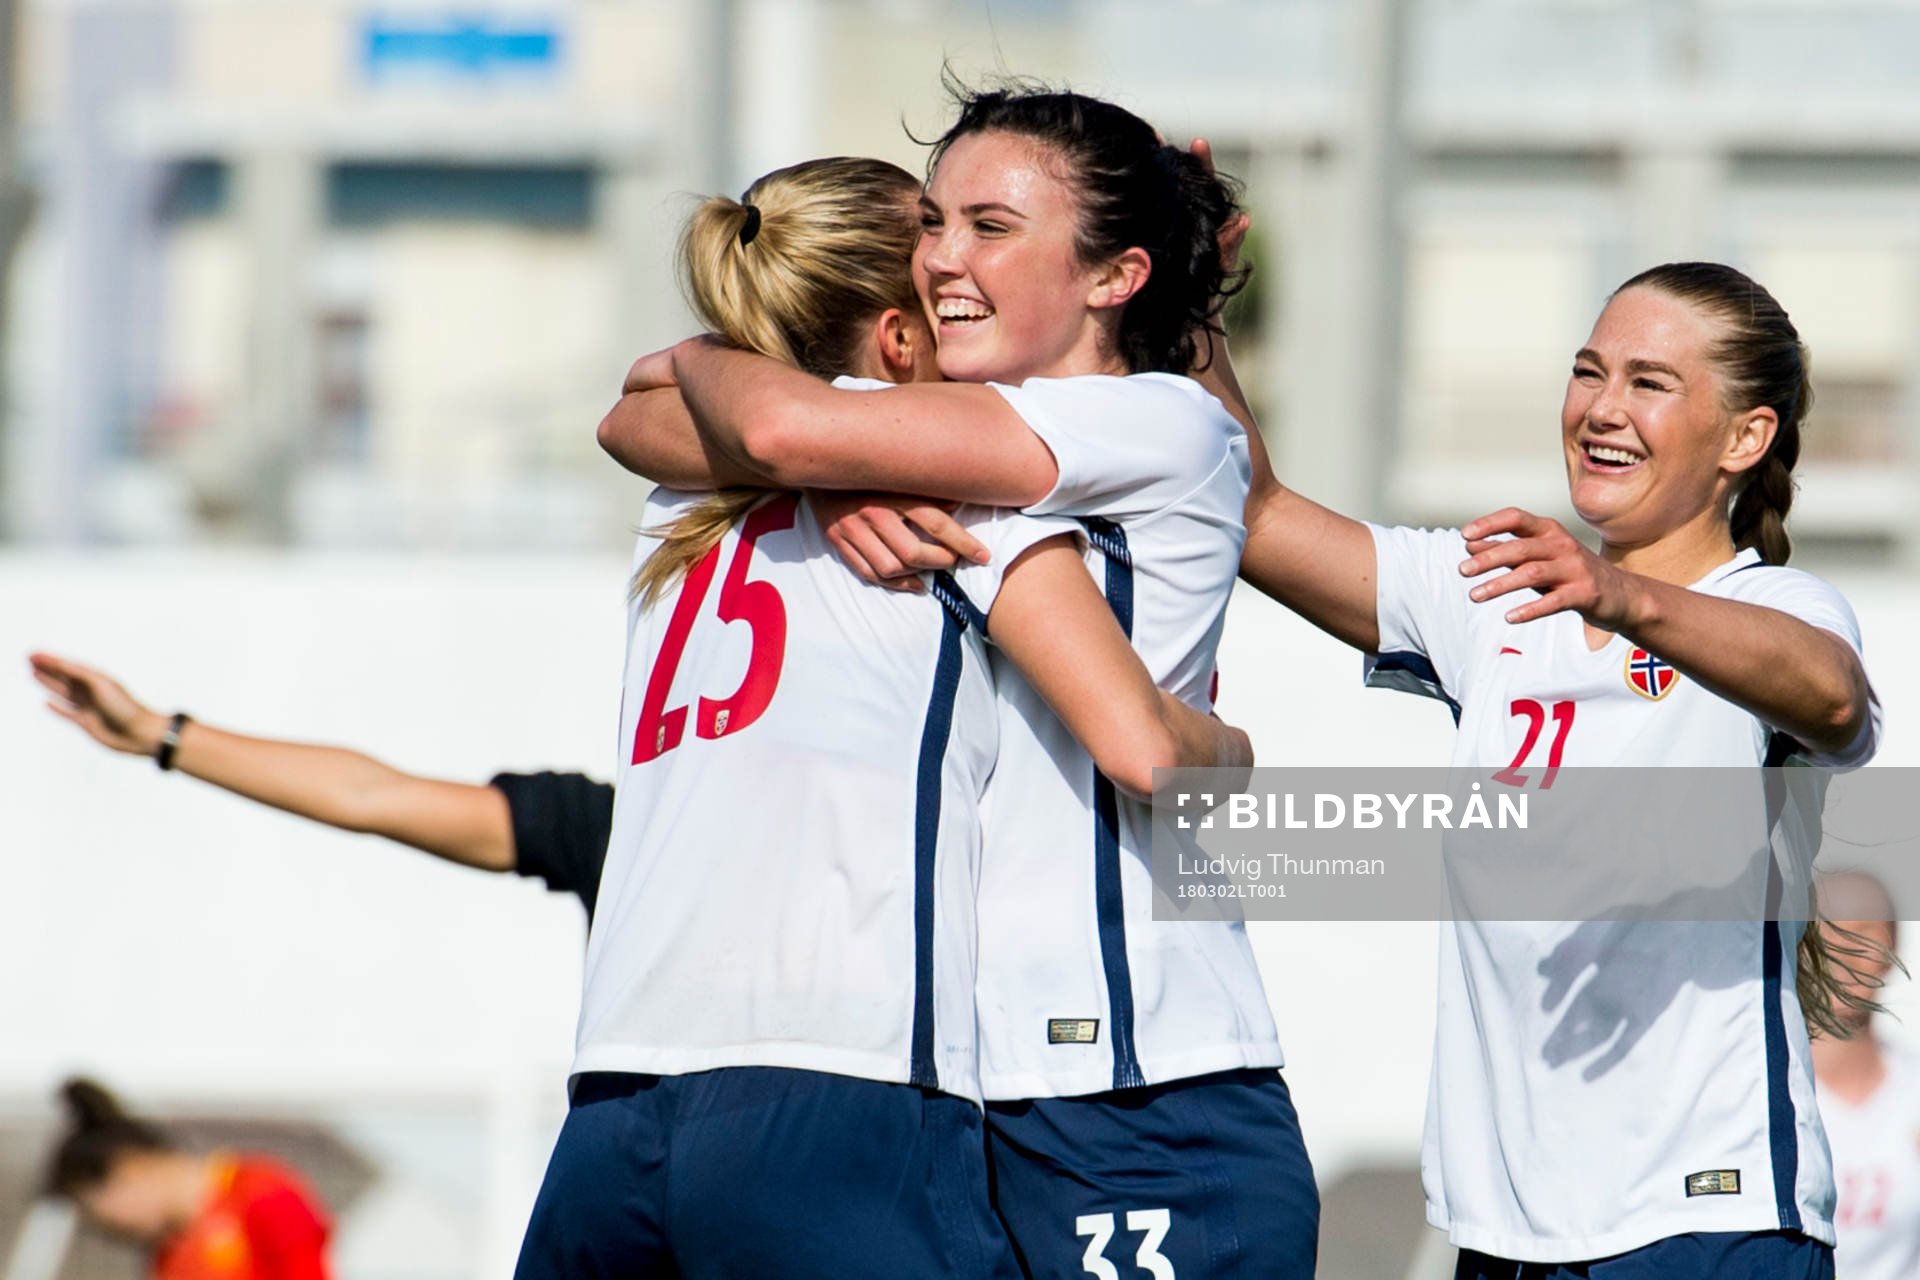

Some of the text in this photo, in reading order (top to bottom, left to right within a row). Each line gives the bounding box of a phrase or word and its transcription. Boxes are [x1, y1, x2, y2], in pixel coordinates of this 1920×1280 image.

[631, 492, 801, 766] 25
[1490, 698, 1576, 789] 21
[1076, 1208, 1175, 1280] 33
